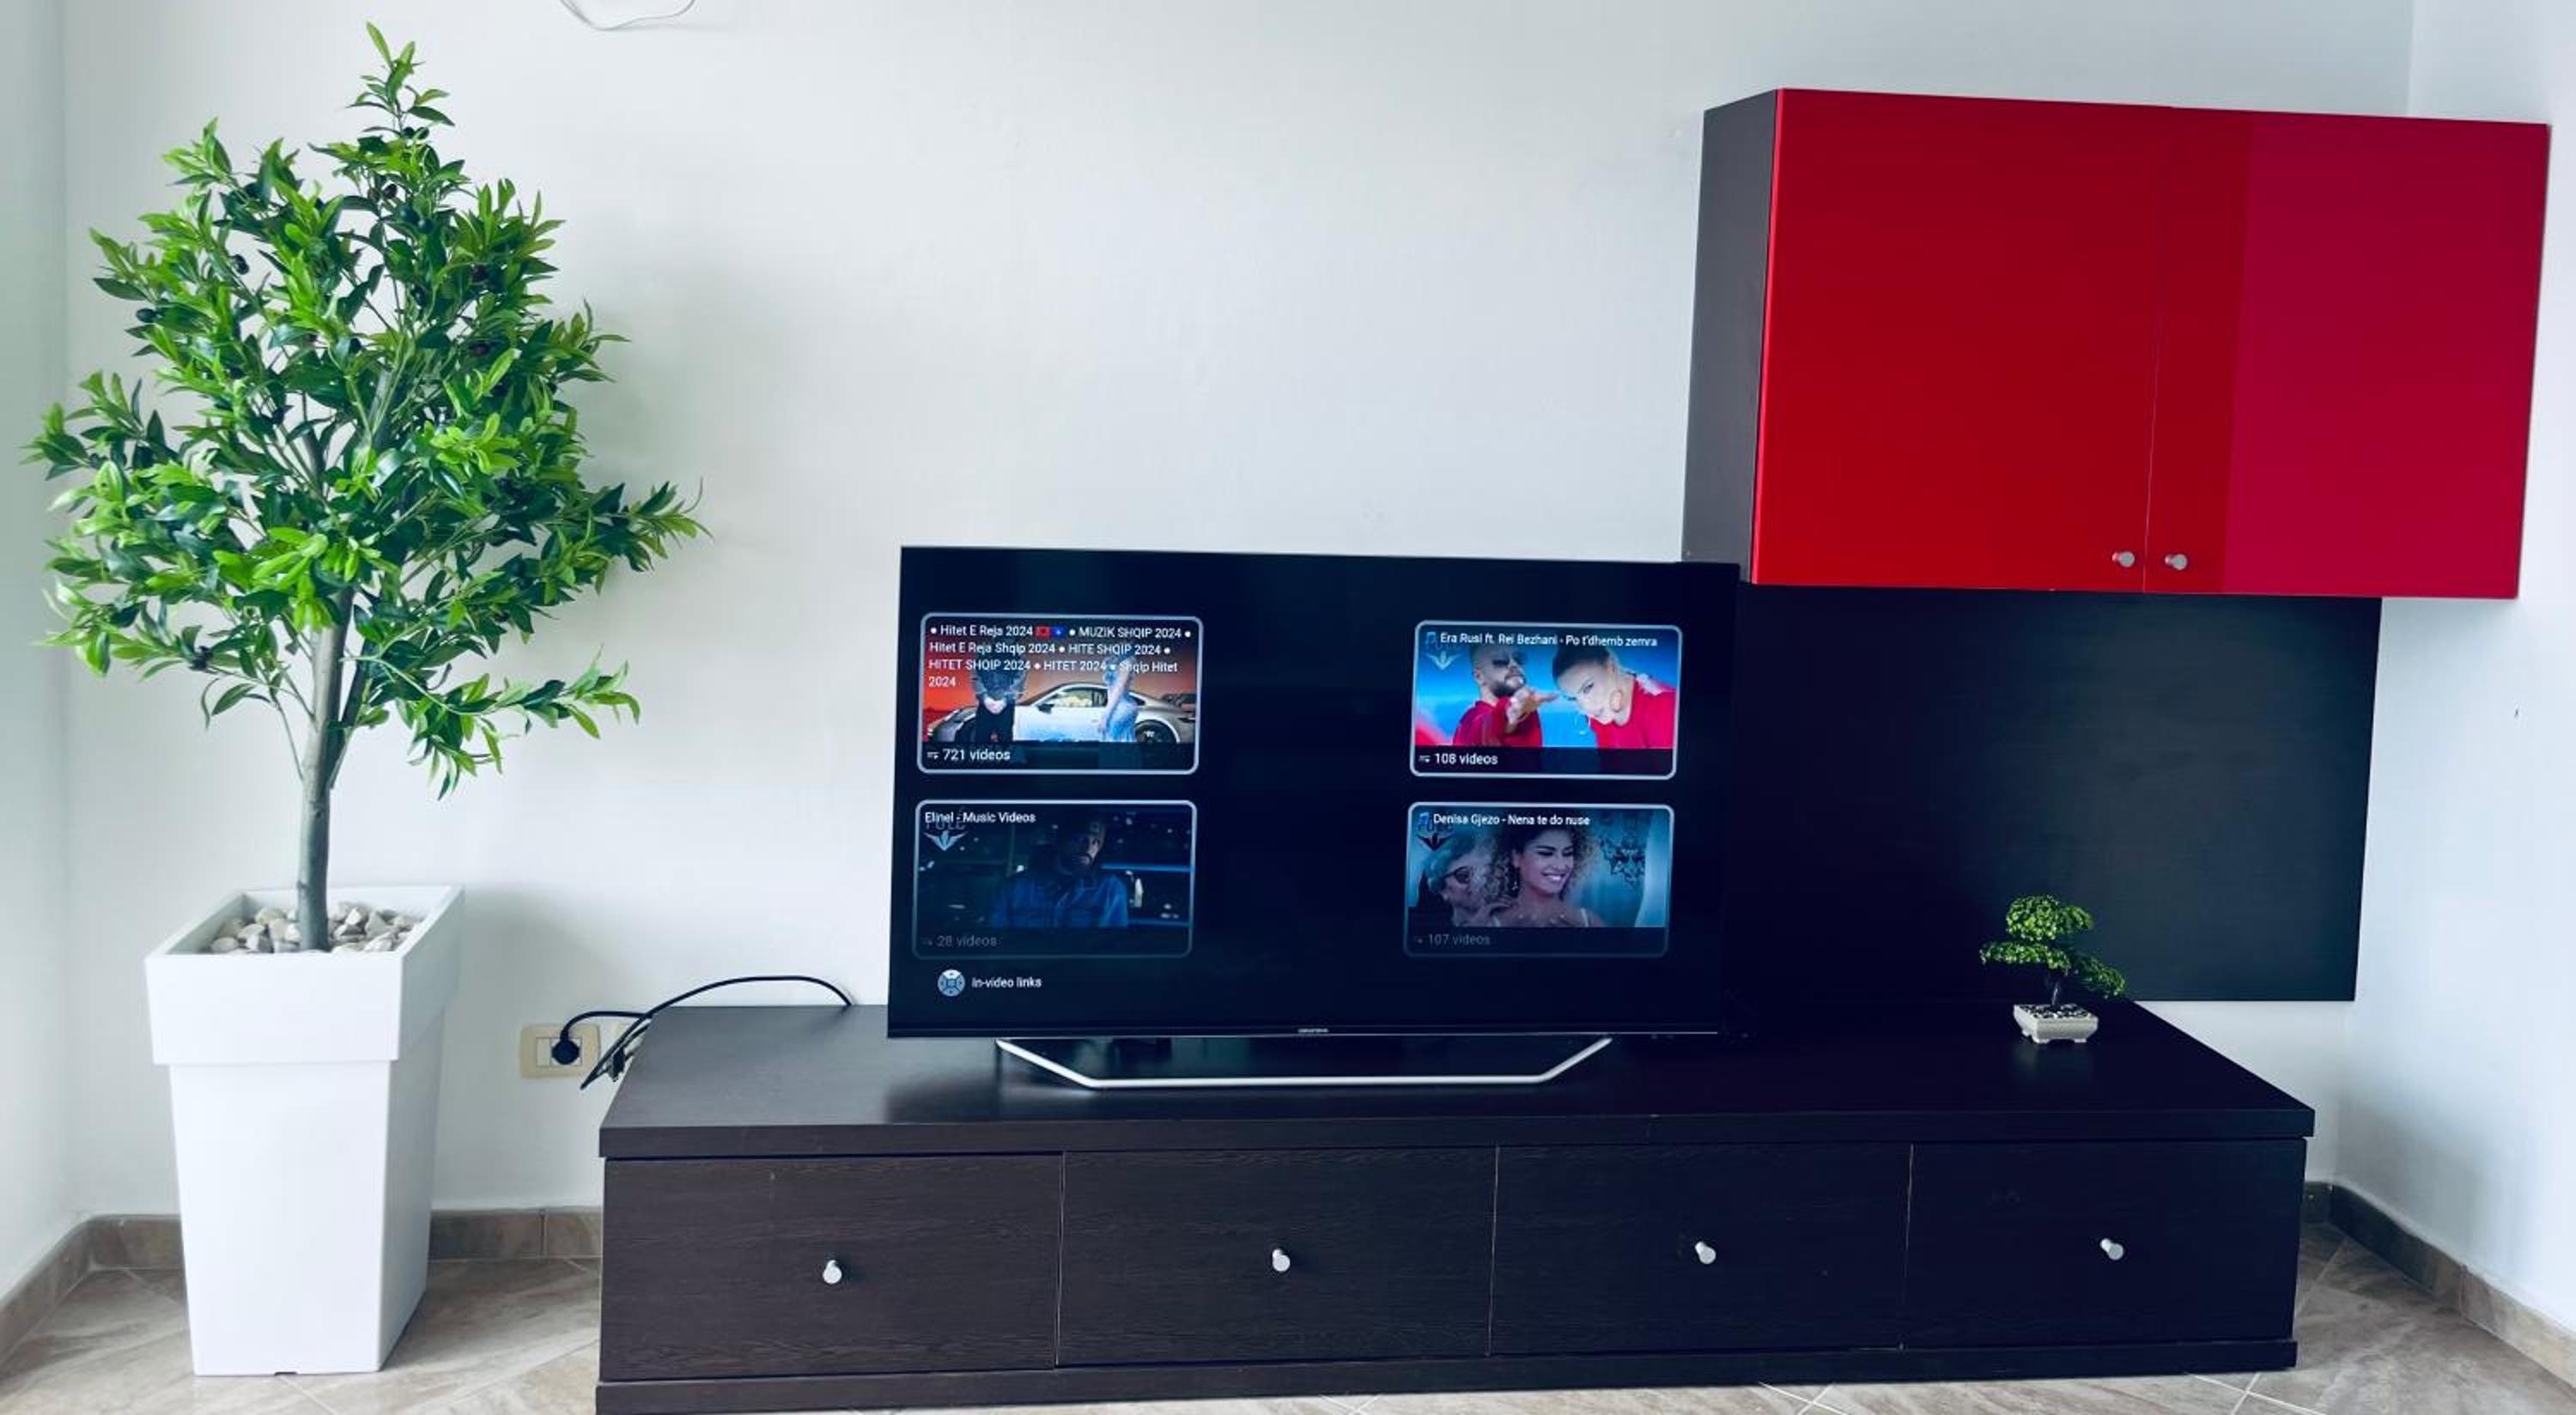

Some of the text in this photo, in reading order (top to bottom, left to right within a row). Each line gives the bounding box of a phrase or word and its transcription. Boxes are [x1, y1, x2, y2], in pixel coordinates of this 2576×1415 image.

[940, 625, 1182, 639] Hitet E Reja 2024 MUZIK SHQIP 2024
[1440, 632, 1457, 643] Era
[1517, 634, 1558, 645] Bezhani
[1566, 635, 1581, 646] Po
[1582, 635, 1624, 647] t'dhemb
[1625, 637, 1658, 647] zemra
[930, 642, 1161, 656] Hitet E Reja Shqip 2024 HITE SHQIP 2024
[929, 659, 963, 670] HITET
[1003, 659, 1031, 671] 2024
[1043, 660, 1077, 671] HITET
[1079, 660, 1107, 671] 2024
[1151, 662, 1178, 672] Hitet
[928, 676, 957, 687] 2024
[943, 749, 1012, 761] 721 videos
[1435, 753, 1498, 765] 108 videos
[925, 812, 954, 823] Elinel
[963, 812, 996, 823] Music
[998, 812, 1036, 823] Videos
[1433, 813, 1469, 824] Denisa
[1471, 813, 1500, 827] Gjezo
[1508, 814, 1535, 824] Nena
[1536, 815, 1548, 825] te
[1549, 814, 1564, 825] do
[1565, 817, 1590, 825] nuse
[957, 935, 997, 947] videos
[1429, 933, 1490, 945] 107 videos
[971, 977, 1042, 988] In-video links
